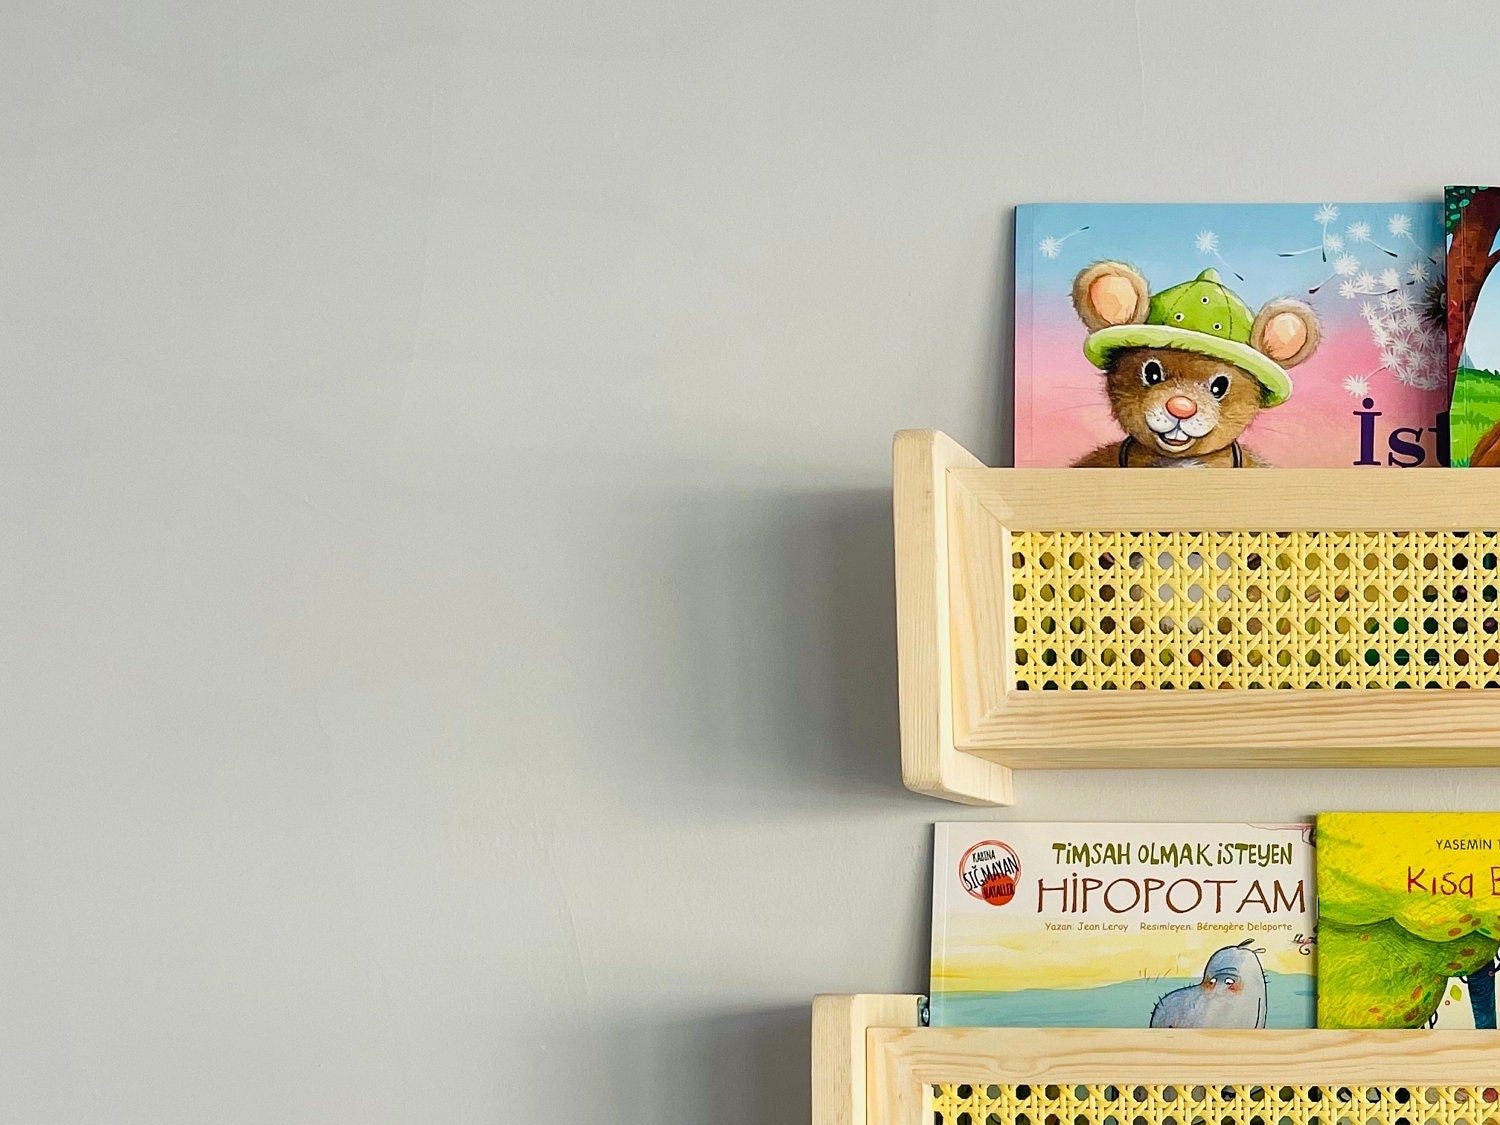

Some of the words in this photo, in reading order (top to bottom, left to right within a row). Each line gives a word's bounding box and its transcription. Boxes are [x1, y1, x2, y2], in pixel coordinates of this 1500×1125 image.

[1138, 842, 1213, 868] OLMAK
[1436, 838, 1492, 850] YASEMİN
[962, 854, 1019, 892] SIĞMAYAN
[1407, 865, 1474, 899] Kısa
[1037, 872, 1306, 914] HİPOPOTAM
[1077, 922, 1100, 931] Jean
[1102, 922, 1129, 933] Leroy
[1247, 921, 1293, 933] Delaporte
